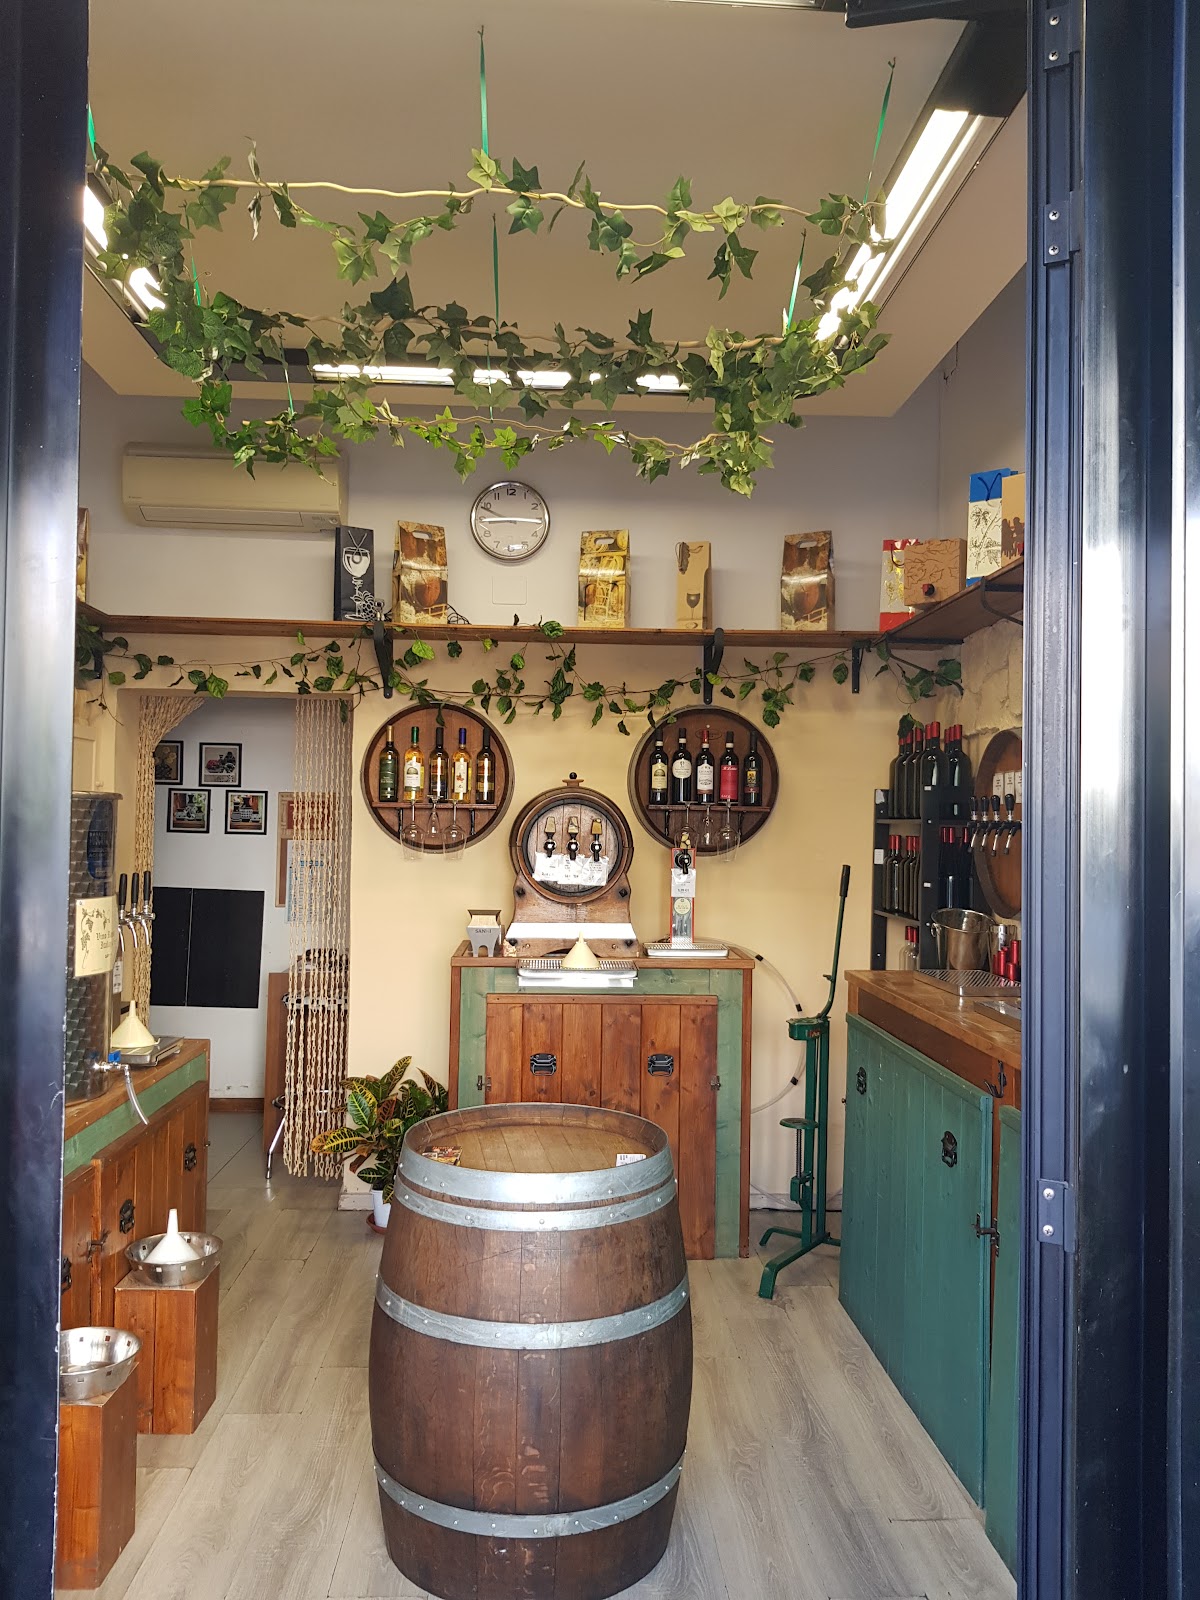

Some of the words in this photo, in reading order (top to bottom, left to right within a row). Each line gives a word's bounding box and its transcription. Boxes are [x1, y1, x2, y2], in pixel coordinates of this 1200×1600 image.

[506, 488, 517, 496] 12
[523, 492, 527, 500] 1
[494, 492, 500, 501] 11
[531, 503, 539, 511] 2
[483, 530, 491, 538] 8
[531, 530, 539, 538] 4
[493, 541, 500, 549] 7
